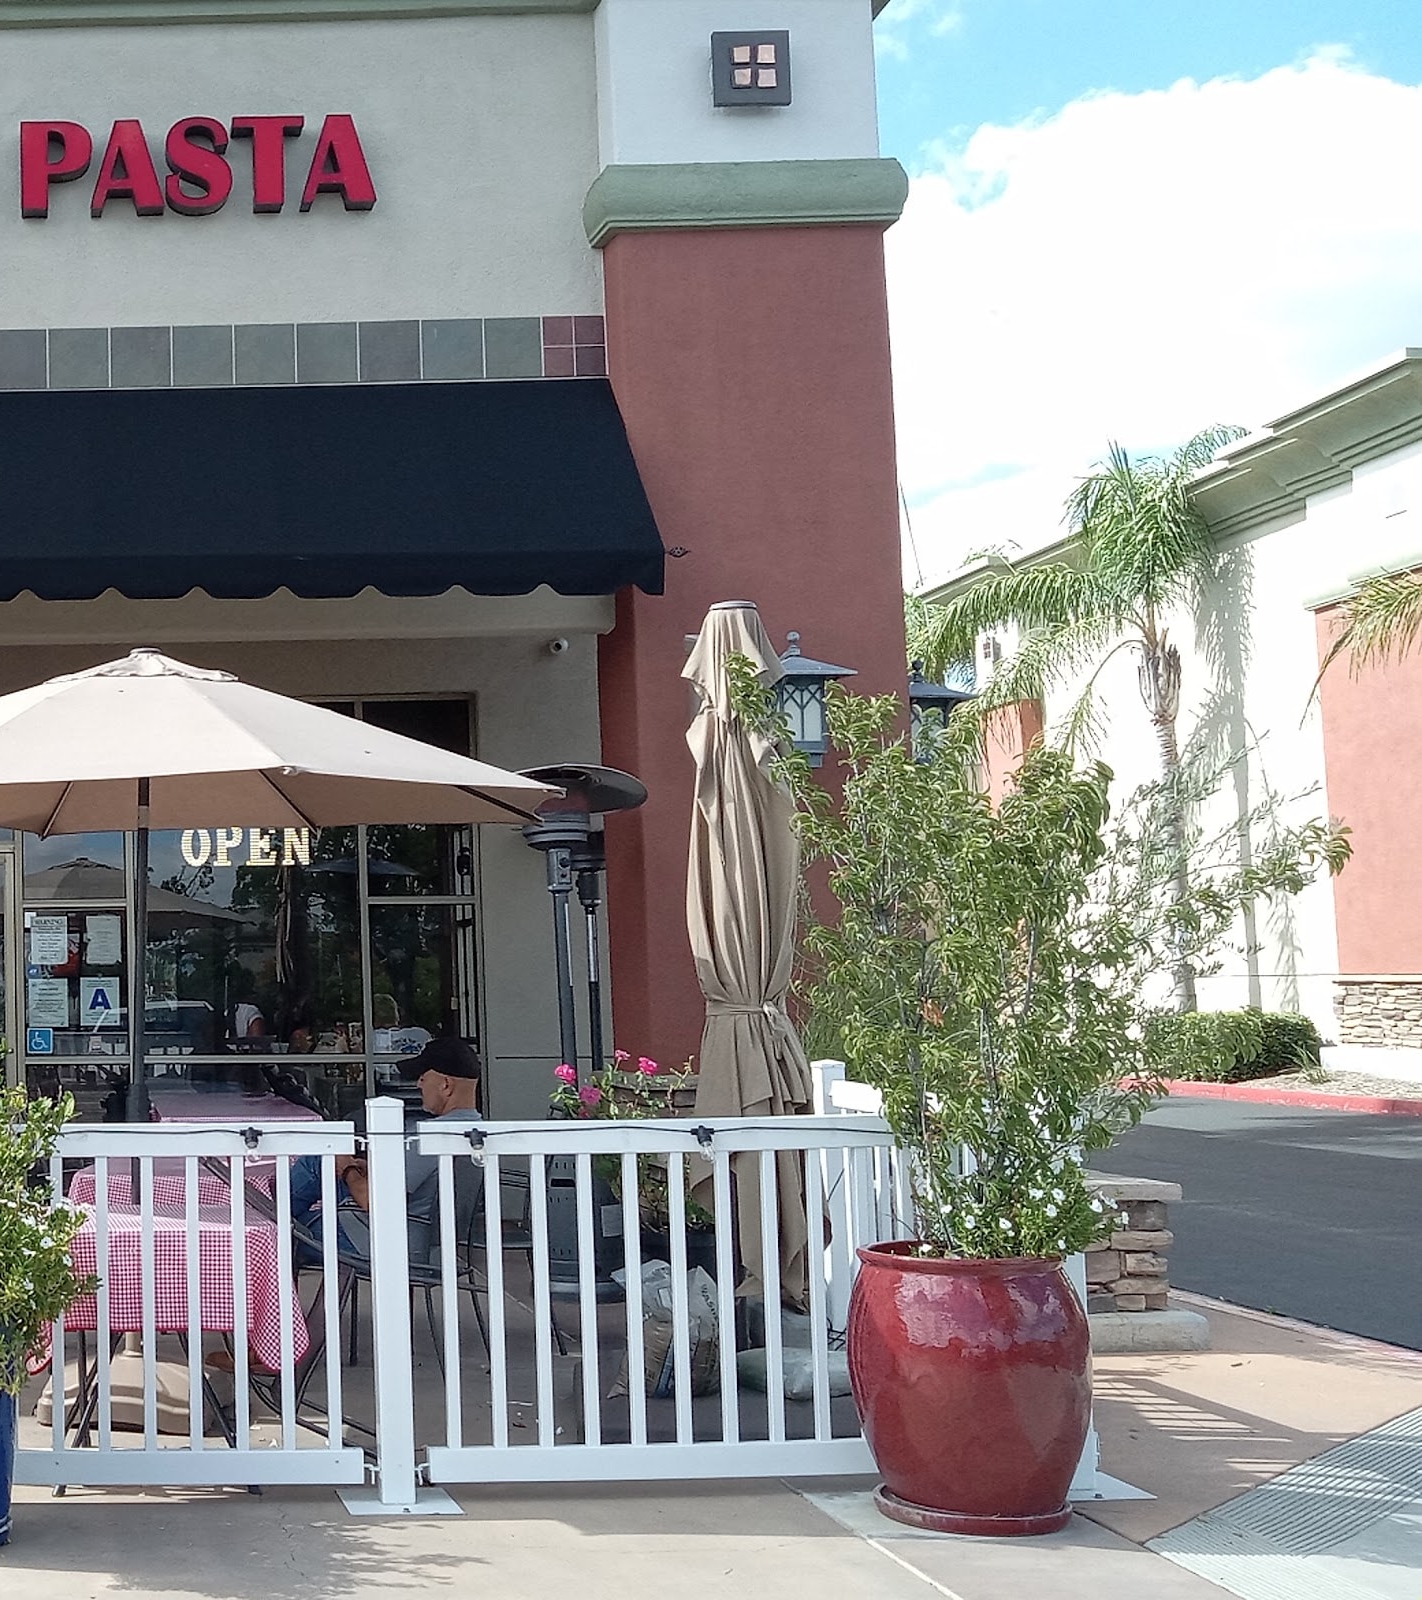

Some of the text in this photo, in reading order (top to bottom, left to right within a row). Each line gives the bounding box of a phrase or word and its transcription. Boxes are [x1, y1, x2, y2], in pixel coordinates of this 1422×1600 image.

[20, 113, 377, 219] PASTA
[180, 826, 311, 867] OPEN
[89, 988, 112, 1010] A
